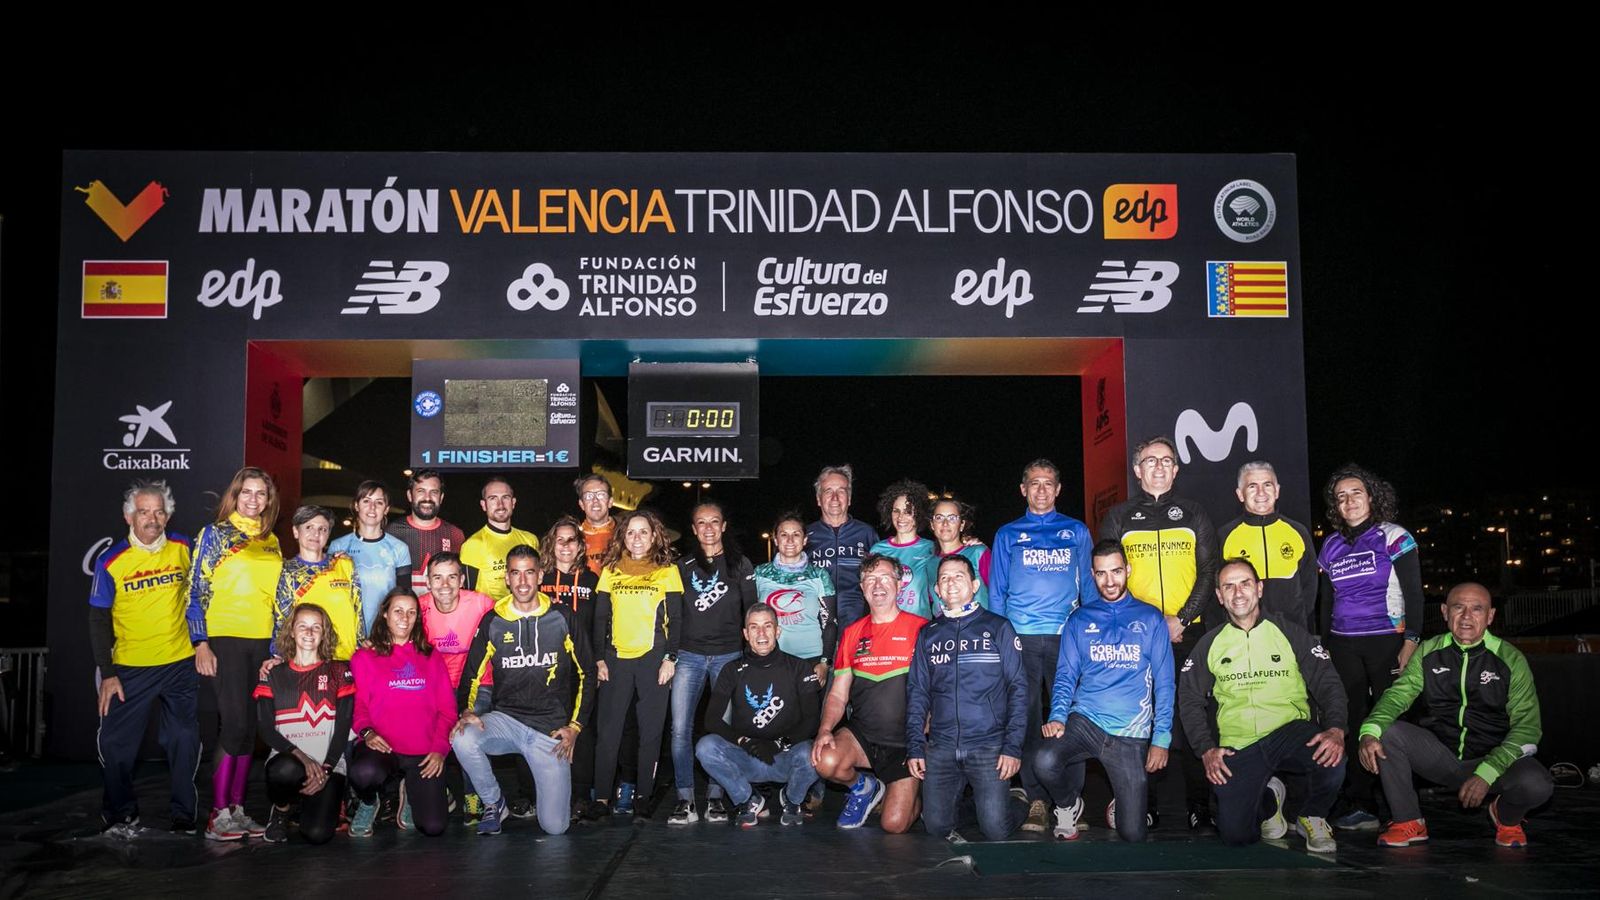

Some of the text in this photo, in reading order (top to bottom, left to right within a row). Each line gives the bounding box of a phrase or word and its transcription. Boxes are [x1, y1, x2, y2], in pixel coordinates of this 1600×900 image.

[199, 176, 1094, 233] MARATÓN VALENCIA TRINIDAD ALFONSO
[1112, 190, 1168, 226] edp
[579, 255, 697, 270] FUNDACIÓN
[756, 257, 887, 285] Cultura del
[197, 258, 283, 320] edp
[578, 275, 697, 295] TRINIDAD
[951, 258, 1034, 319] edp
[578, 297, 697, 318] ALFONSO
[753, 288, 889, 317] Esfuerzo
[103, 452, 190, 470] CaixaBank
[422, 451, 431, 463] 1
[812, 546, 865, 559] NORTE
[1023, 548, 1071, 558] POBLATS
[1125, 541, 1192, 553] PATERNA RUNNERS
[1037, 563, 1069, 572] Valencia
[124, 571, 184, 593] runners
[571, 585, 592, 595] STOP
[694, 581, 729, 612] 3FDC
[931, 639, 991, 654] NORTE
[1090, 644, 1141, 653] POBLATS
[501, 652, 558, 669] REDOLAT
[1104, 661, 1138, 670] Valencia
[752, 696, 785, 729] 3FDC
